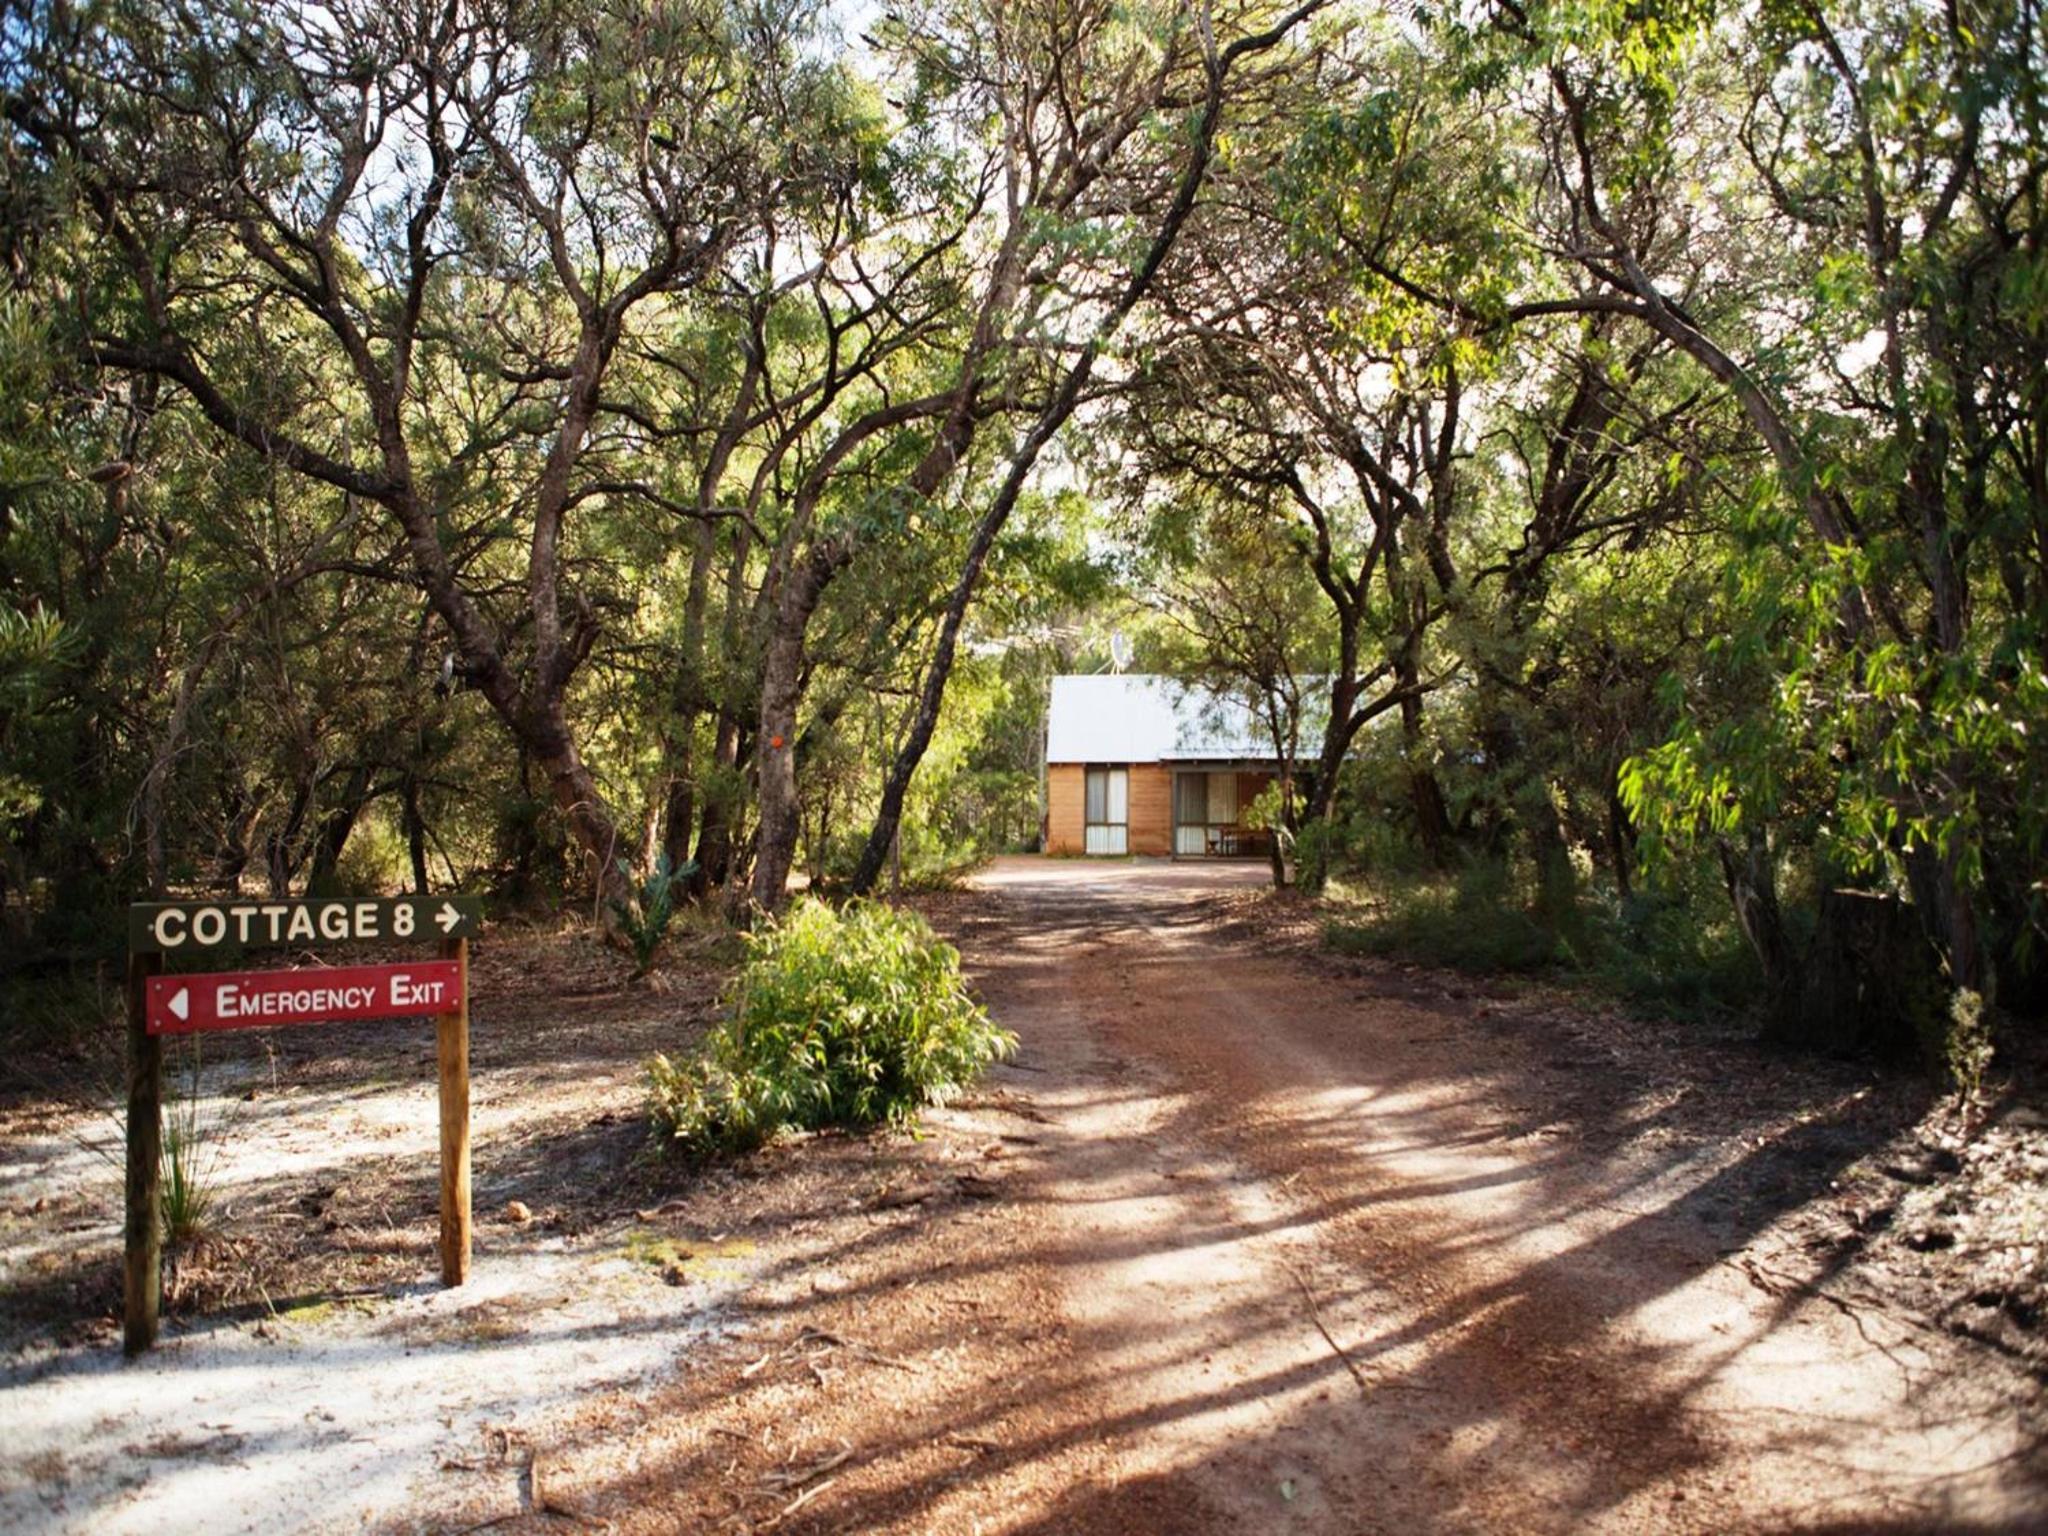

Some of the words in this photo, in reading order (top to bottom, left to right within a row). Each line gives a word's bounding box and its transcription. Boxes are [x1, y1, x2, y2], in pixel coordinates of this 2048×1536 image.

[154, 902, 380, 947] COTTAGE
[393, 902, 416, 937] 8
[216, 984, 376, 1018] EMERGENCY
[390, 974, 445, 1006] EXIT
